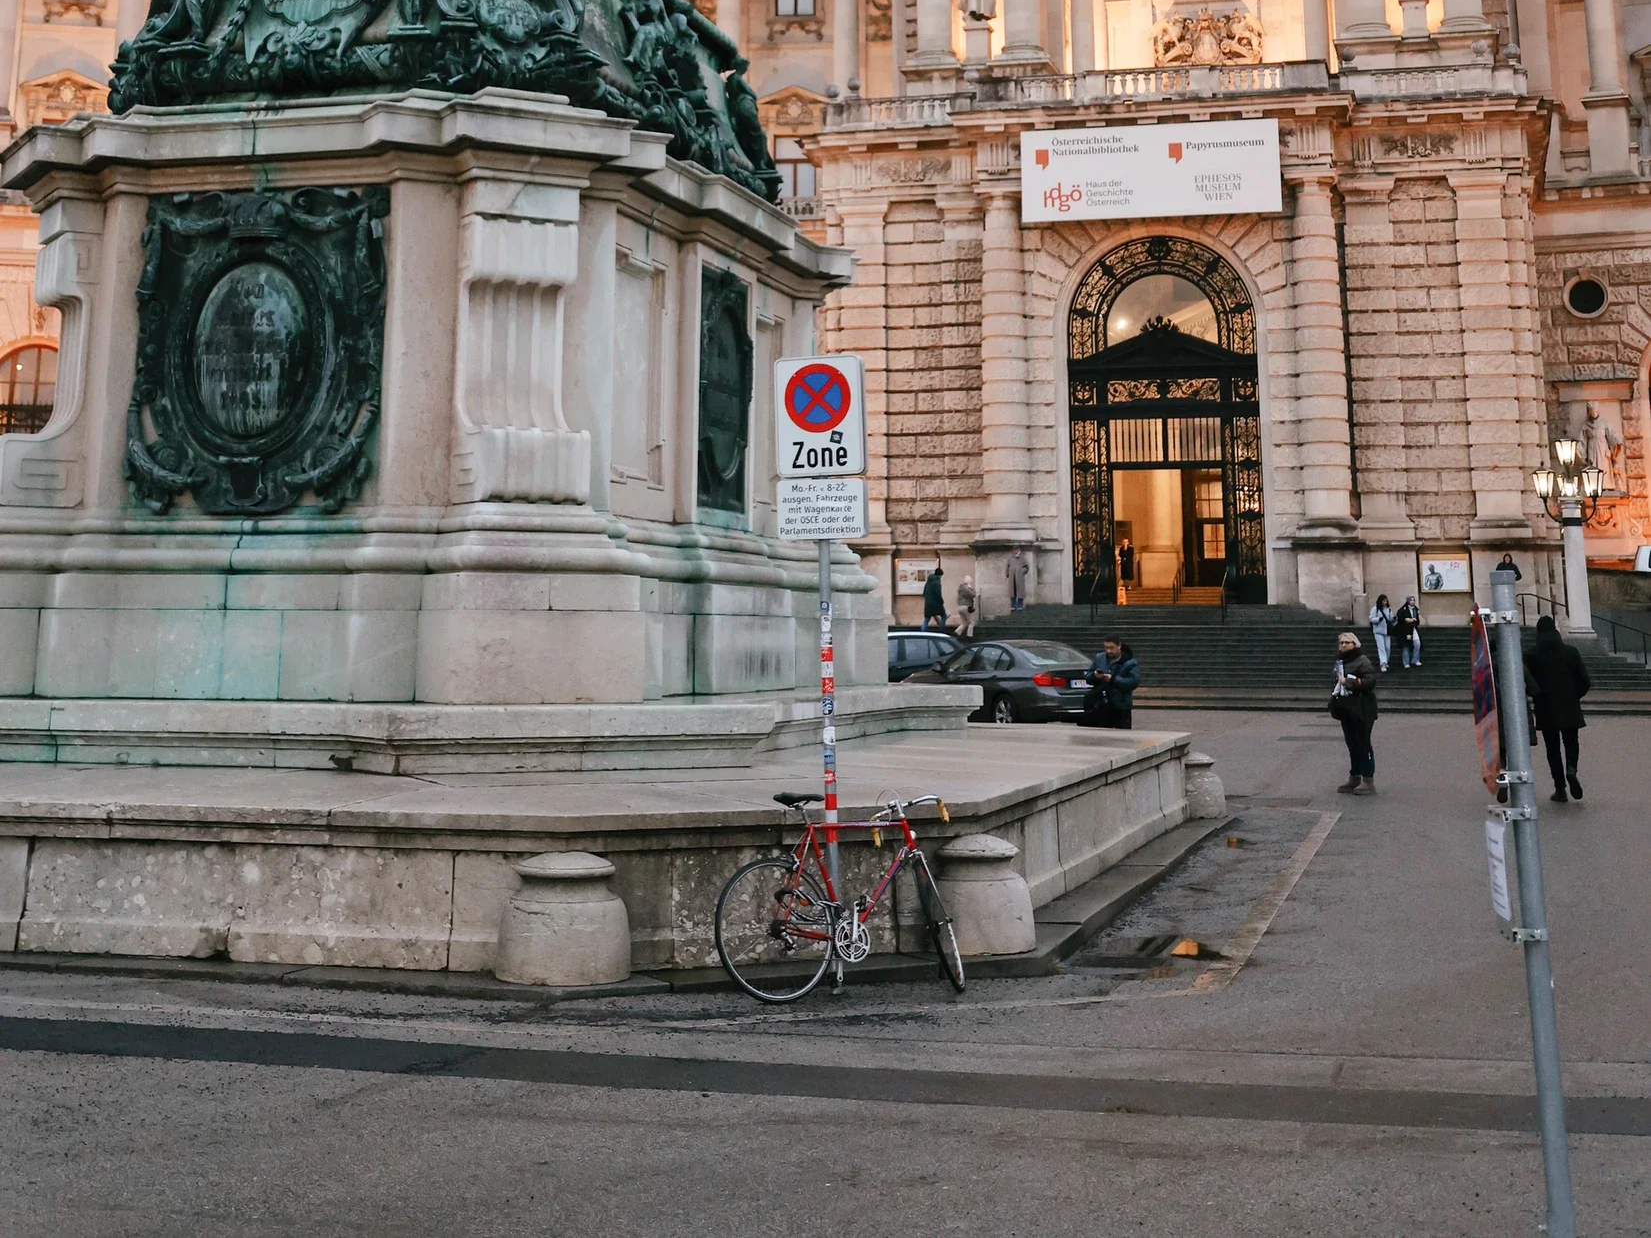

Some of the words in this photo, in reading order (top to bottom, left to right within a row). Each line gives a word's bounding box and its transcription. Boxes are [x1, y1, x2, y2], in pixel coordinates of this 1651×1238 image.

[1051, 135, 1123, 147] Österreichische
[1185, 138, 1265, 151] Papyrusmuseum
[1052, 144, 1140, 157] Nationalbibliothek
[1085, 180, 1107, 188] Haus
[1108, 179, 1122, 187] der
[1194, 173, 1242, 184] EPHESOS
[1085, 188, 1134, 198] Geschichte
[1195, 182, 1241, 193] MUSEUM
[1085, 197, 1131, 207] Österreich
[1204, 192, 1233, 202] WIEN
[791, 441, 848, 469] Zone
[782, 495, 814, 505] ausgen.
[816, 494, 858, 504] Fahrzeuge
[784, 517, 798, 525] der
[800, 515, 820, 525] OSCE
[821, 515, 840, 524] oder
[842, 514, 856, 523] der
[780, 525, 862, 536] Parlamentsdirektion
